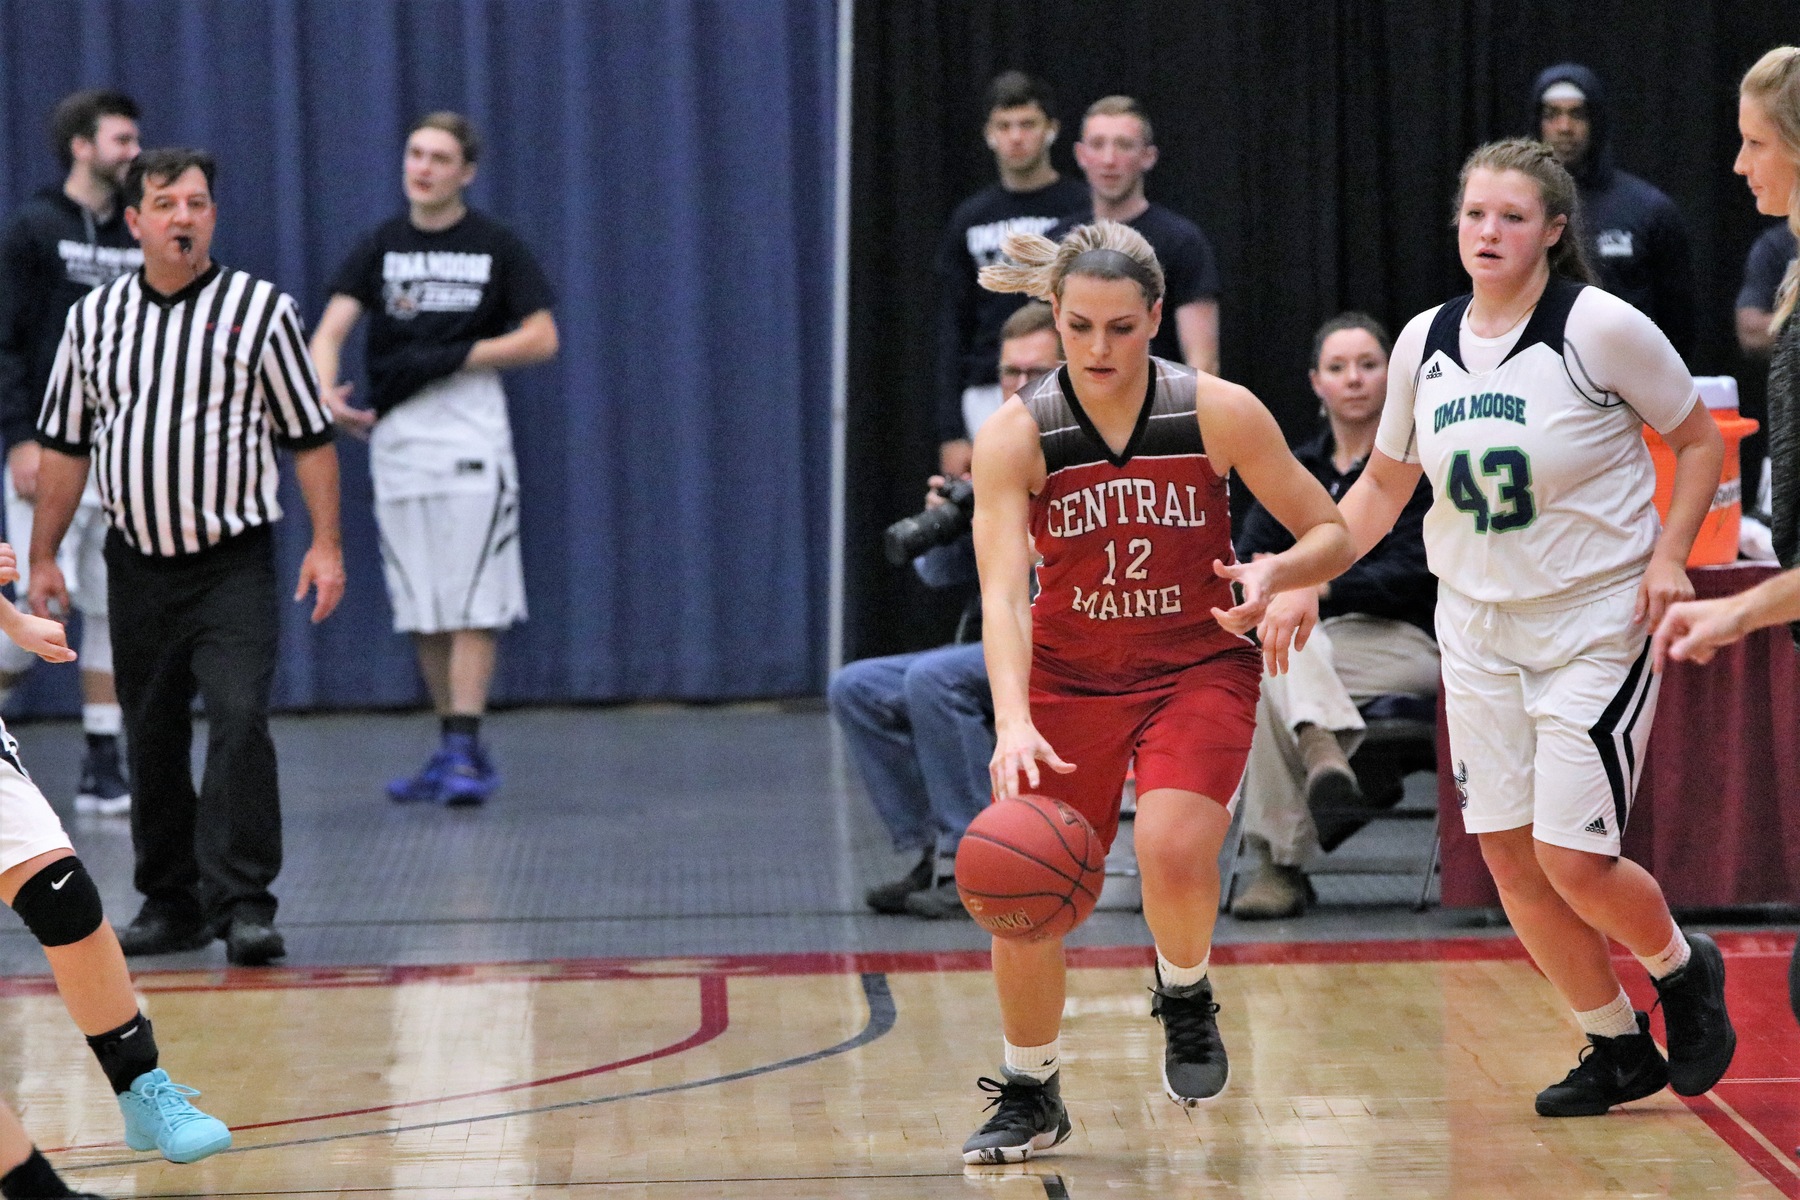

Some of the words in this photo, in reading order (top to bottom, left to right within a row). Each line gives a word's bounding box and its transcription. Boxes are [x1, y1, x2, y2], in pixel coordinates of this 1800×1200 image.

[1433, 396, 1467, 435] UMA
[1468, 392, 1527, 427] MOOSE
[1047, 477, 1206, 538] CENTRAL
[1446, 446, 1537, 535] 43
[1102, 538, 1152, 586] 12
[1072, 584, 1182, 621] MAINE
